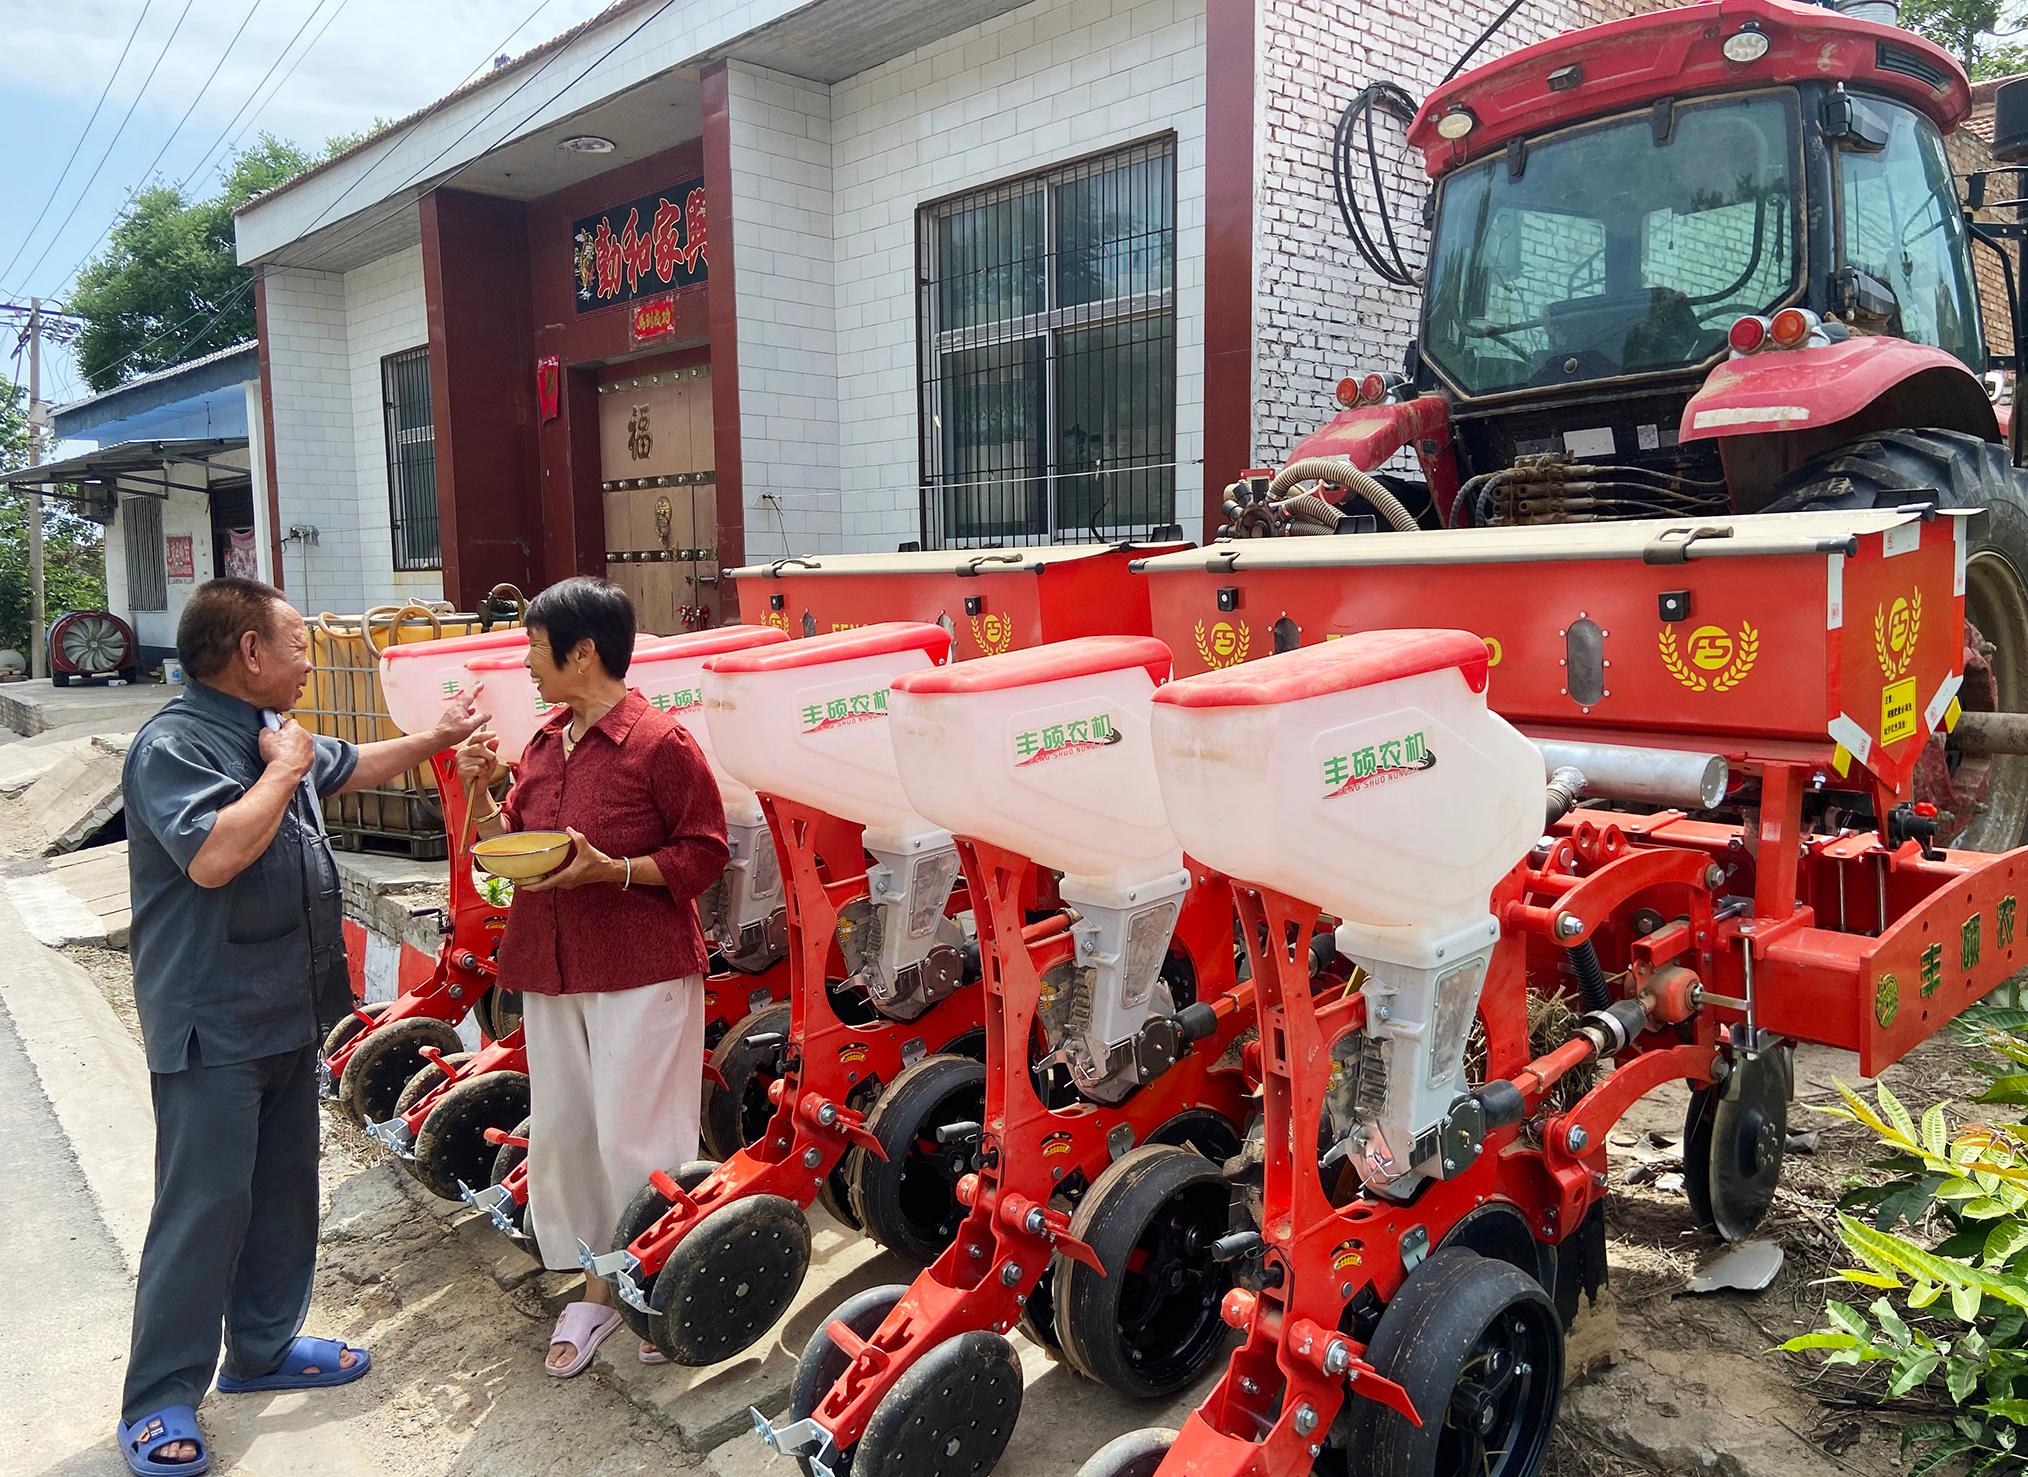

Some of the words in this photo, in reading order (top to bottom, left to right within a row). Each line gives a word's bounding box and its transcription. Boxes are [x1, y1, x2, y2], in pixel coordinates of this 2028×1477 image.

[628, 403, 654, 461] 福
[802, 688, 890, 724] 丰硕农机
[1015, 714, 1113, 756] 丰硕农机
[1323, 731, 1428, 785] 丰硕农机
[1363, 775, 1386, 789] SHUO
[1920, 895, 2028, 998] 丰硕农
